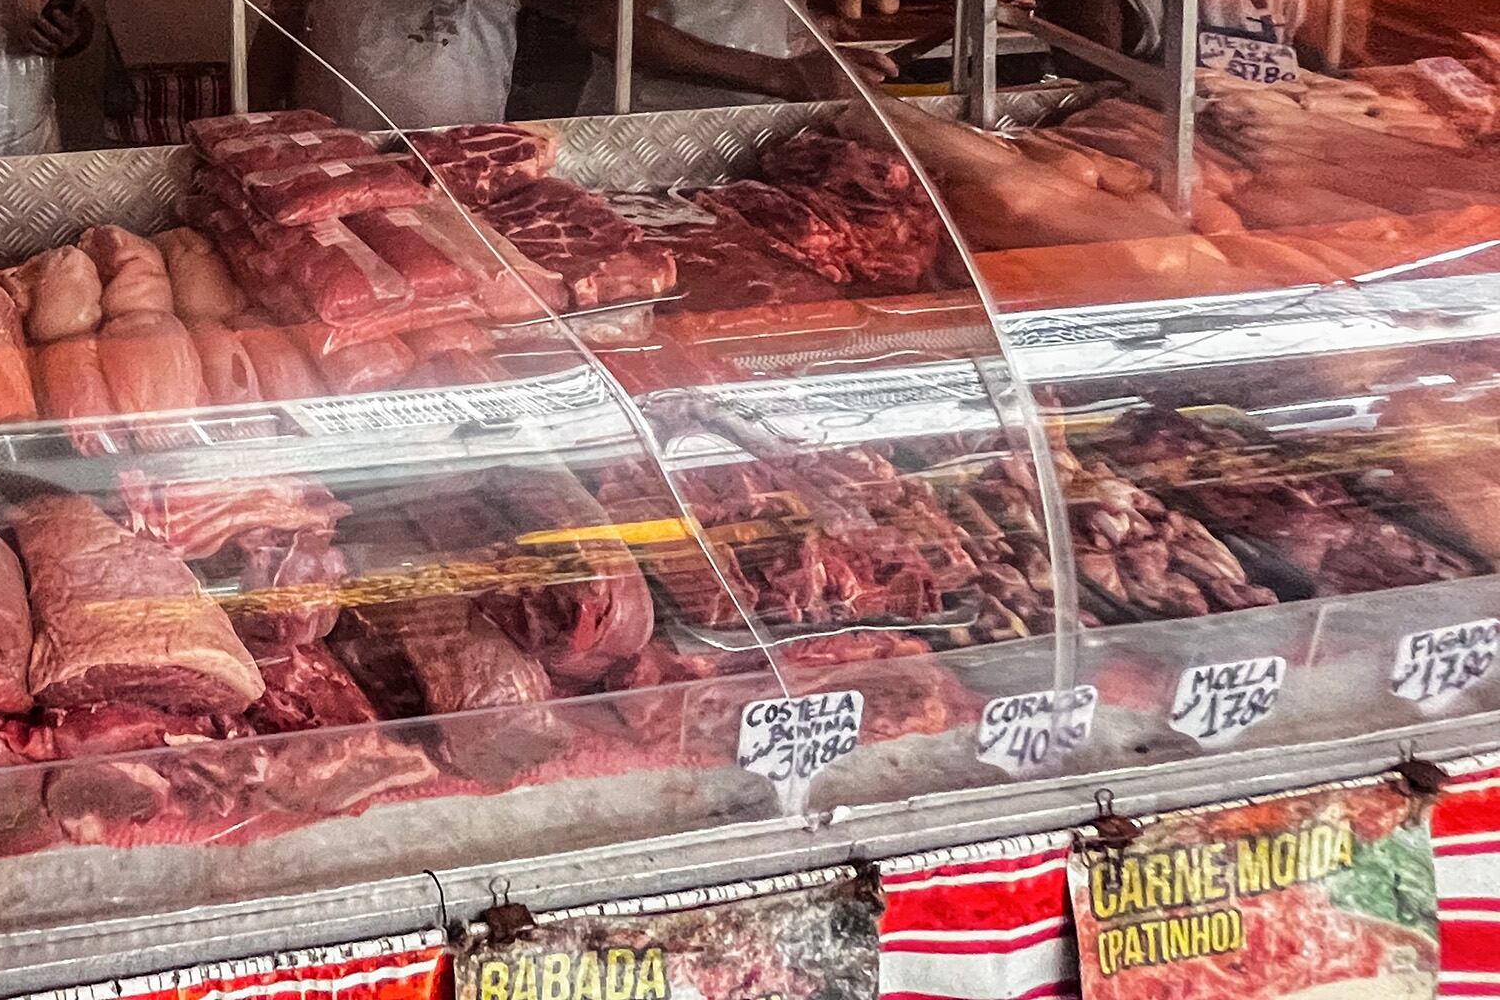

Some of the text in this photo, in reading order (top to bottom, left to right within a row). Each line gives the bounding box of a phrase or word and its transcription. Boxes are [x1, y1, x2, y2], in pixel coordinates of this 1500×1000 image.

[1192, 659, 1276, 694] MOELA
[746, 693, 855, 727] COSTELA
[1091, 842, 1228, 919] CARNE
[1098, 909, 1244, 976] (PATINHO)
